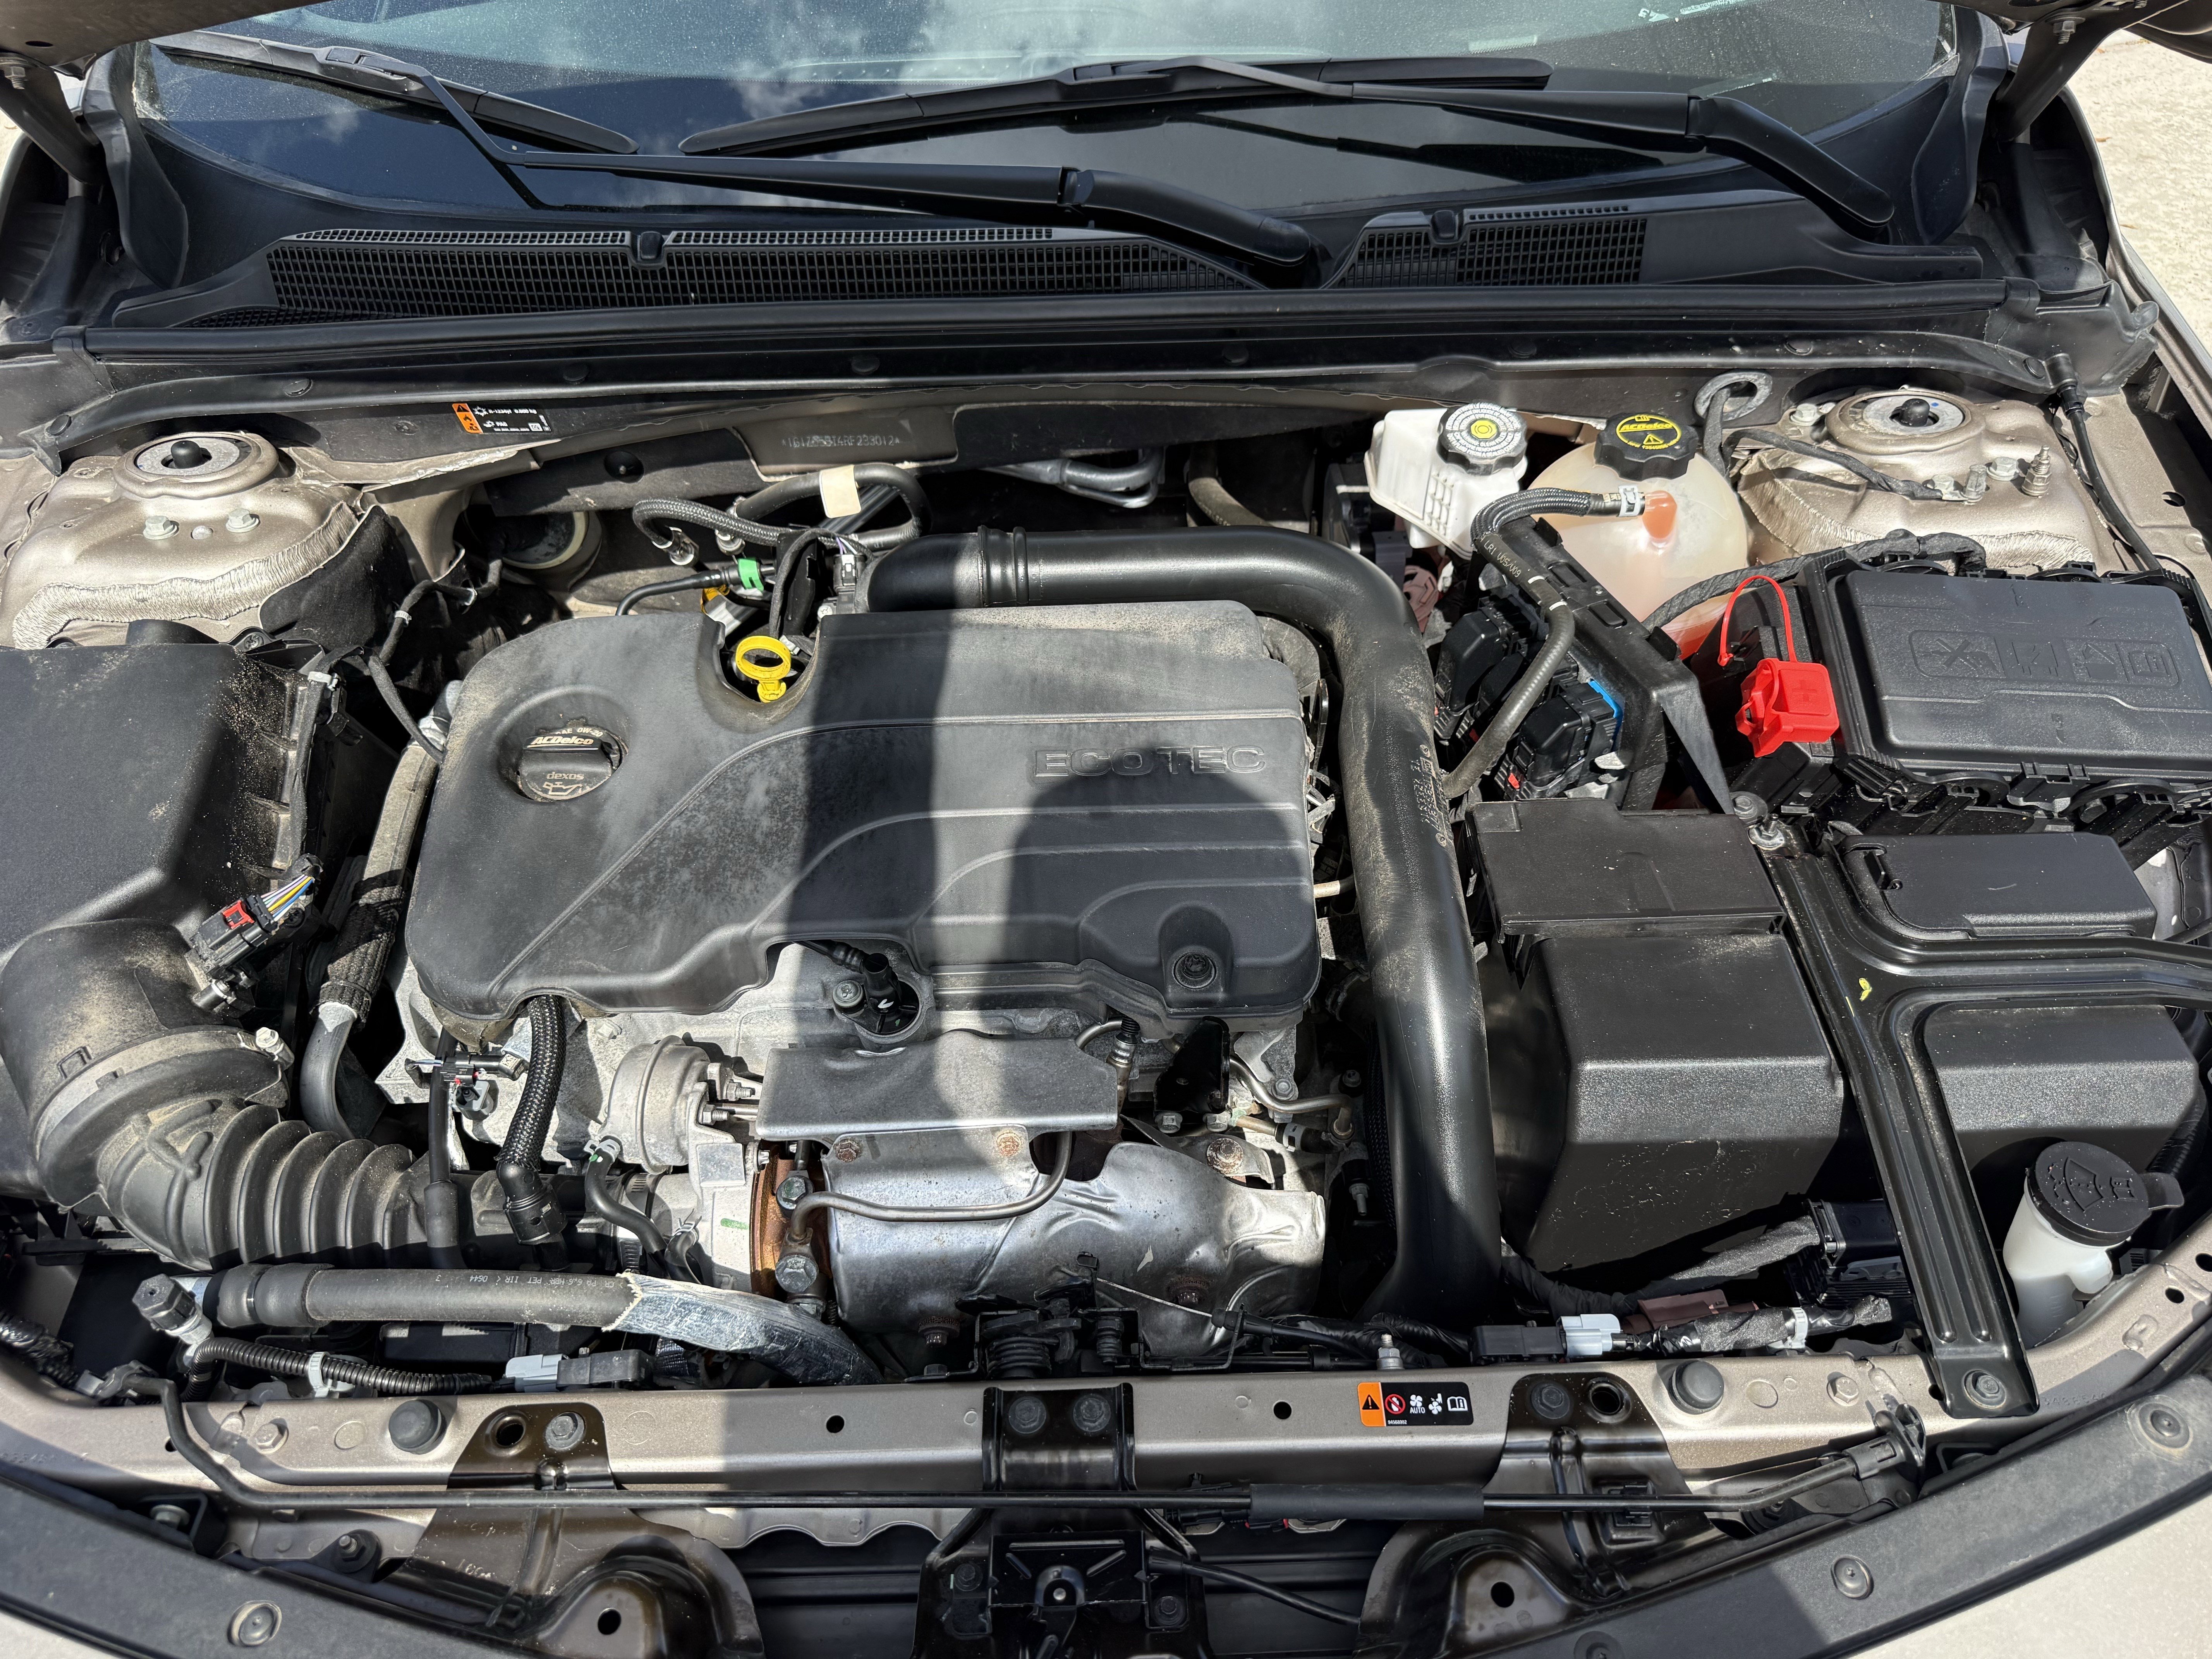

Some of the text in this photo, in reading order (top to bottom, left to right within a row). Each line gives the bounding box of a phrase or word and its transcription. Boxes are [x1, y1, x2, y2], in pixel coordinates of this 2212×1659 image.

[577, 727, 603, 737] 0W-20
[531, 736, 594, 745] ACDelco
[1034, 745, 1266, 776] ECOTEC
[546, 771, 584, 780] dexos
